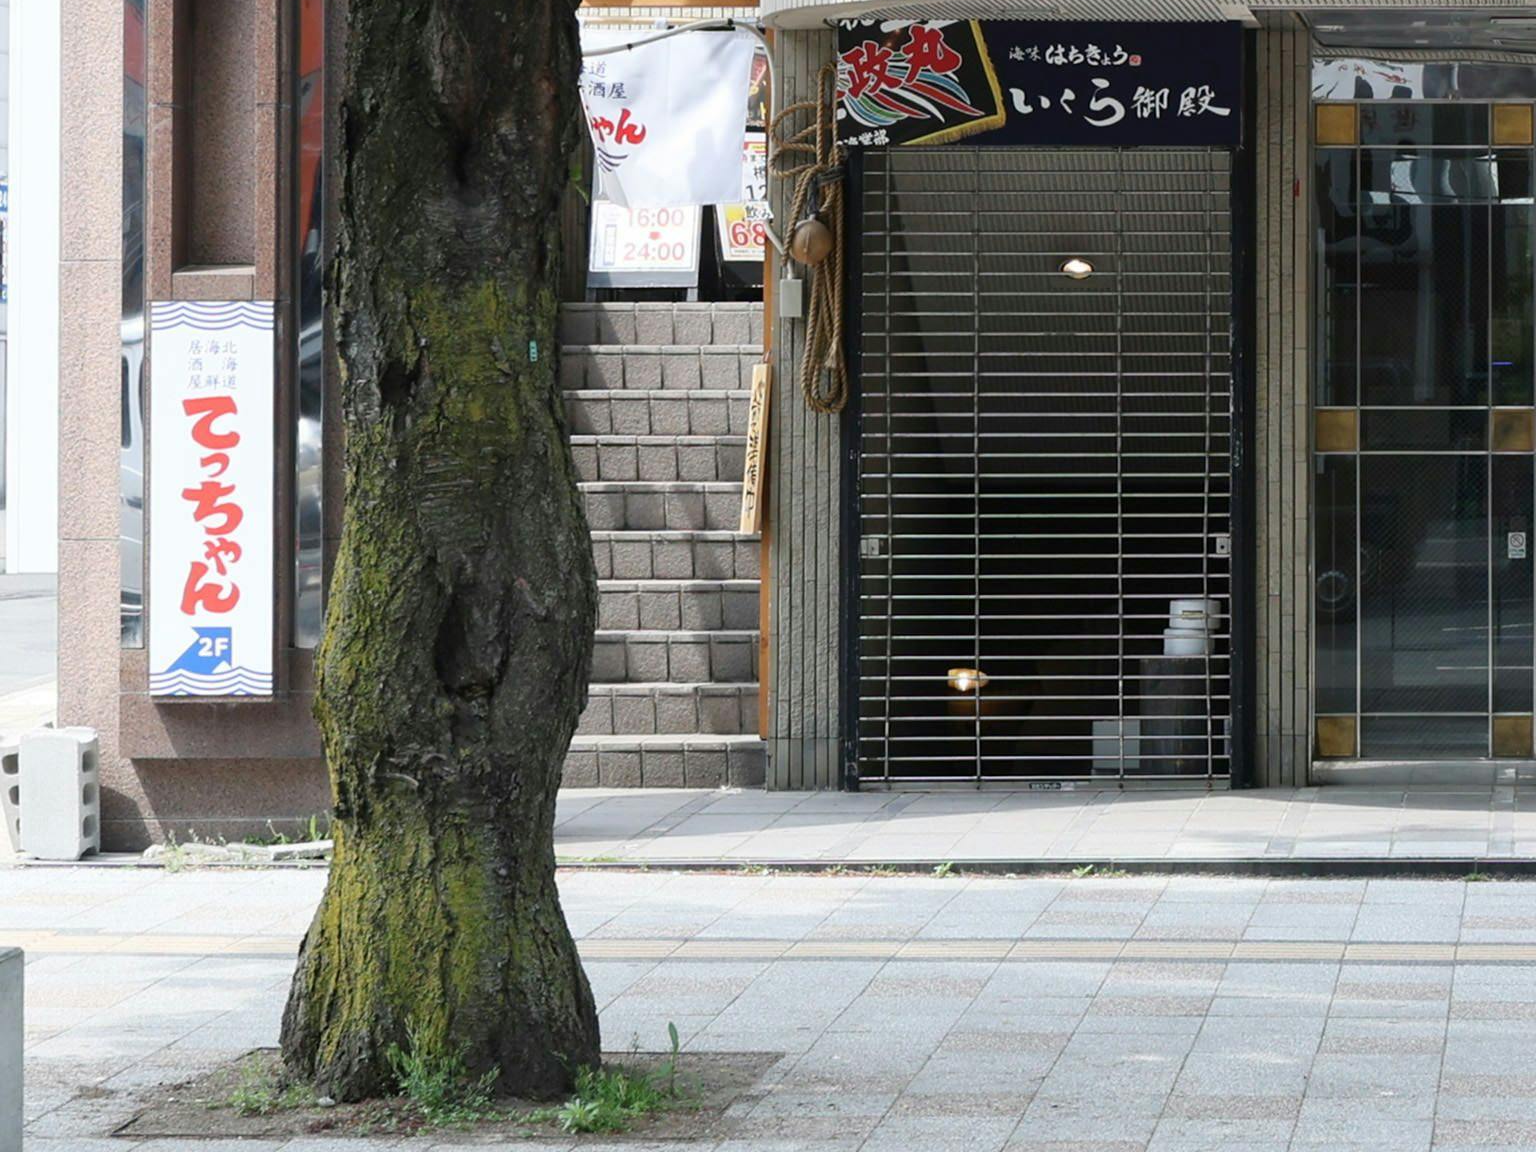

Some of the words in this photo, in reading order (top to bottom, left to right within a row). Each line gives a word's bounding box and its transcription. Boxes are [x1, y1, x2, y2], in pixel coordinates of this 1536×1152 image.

[838, 24, 963, 100] 政丸
[580, 79, 628, 99] 酒屋
[1009, 77, 1232, 128] いくら御殿
[588, 105, 646, 145] ゃん
[623, 241, 685, 261] 24:00
[181, 395, 244, 615] てっちゃん
[198, 635, 230, 657] 2F
